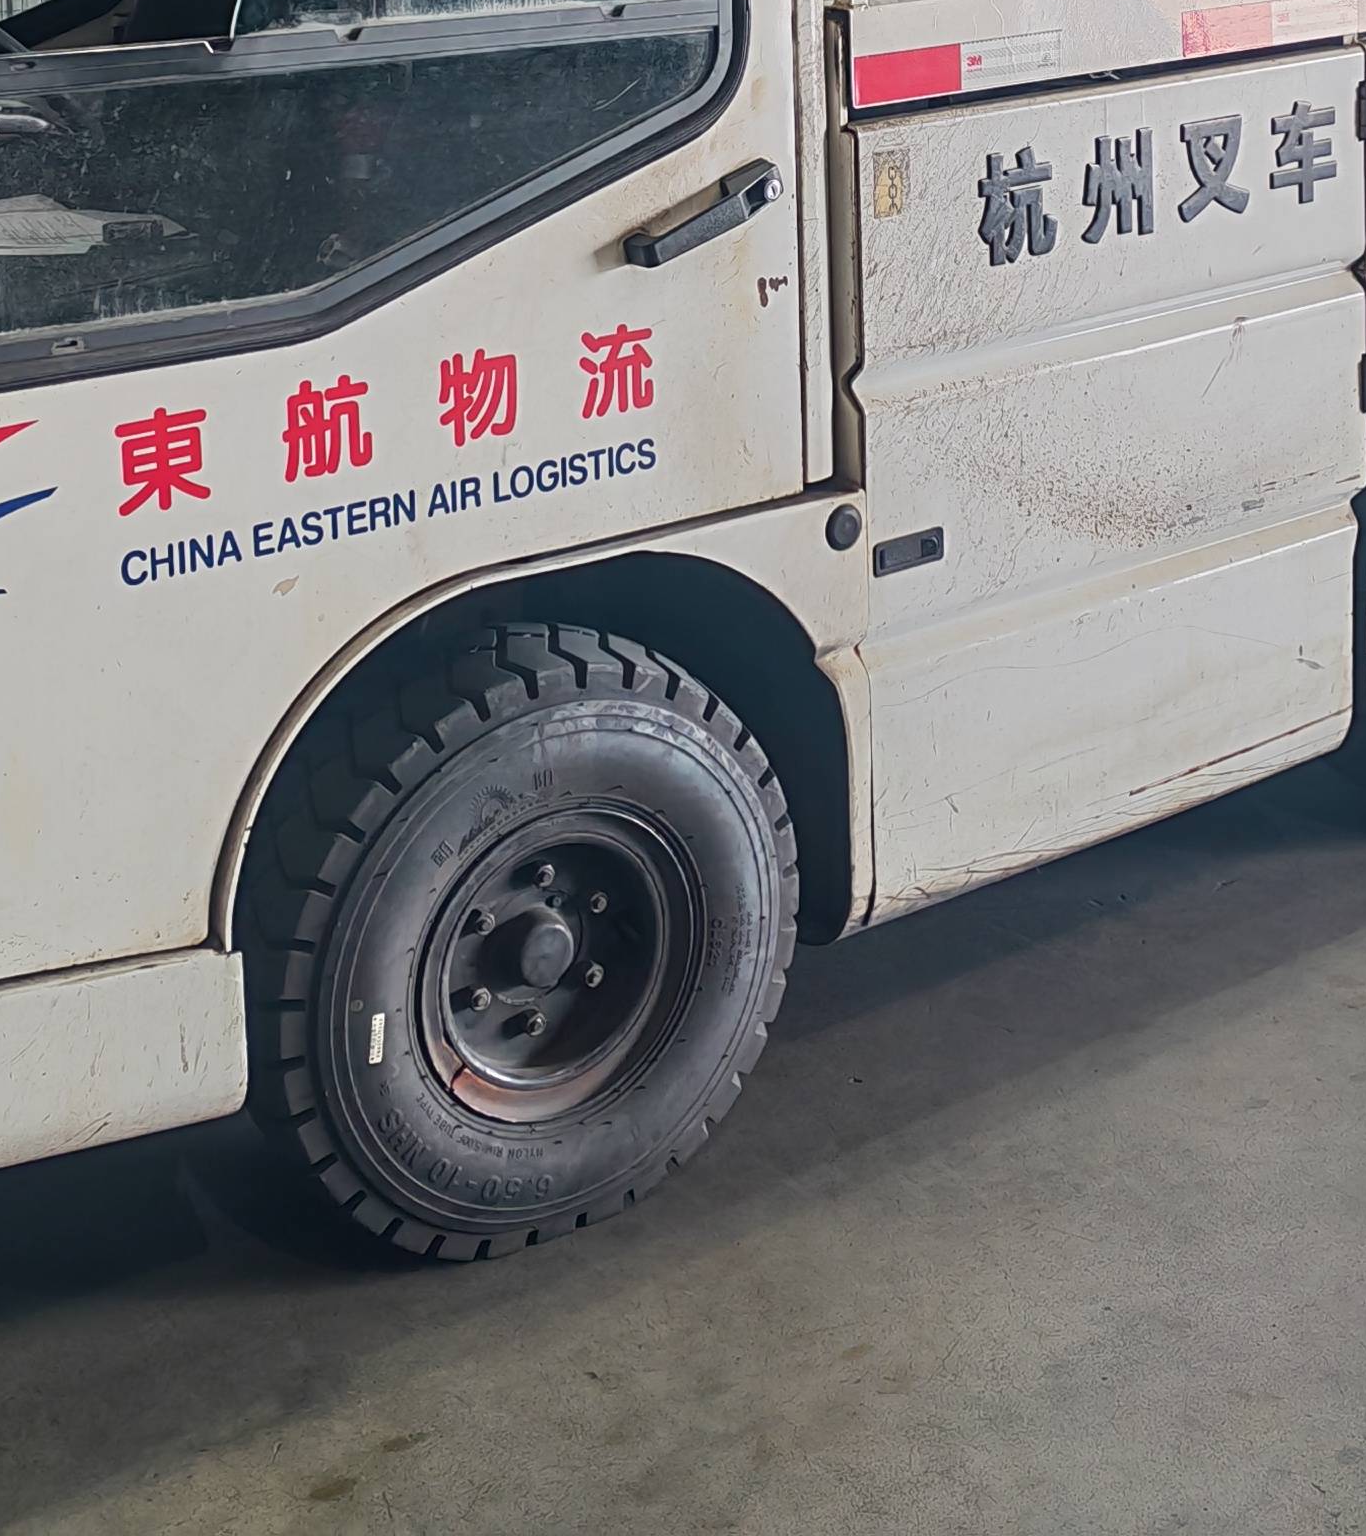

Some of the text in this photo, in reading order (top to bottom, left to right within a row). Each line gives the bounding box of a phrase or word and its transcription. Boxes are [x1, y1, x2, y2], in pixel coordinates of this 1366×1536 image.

[966, 55, 983, 67] 3M
[978, 100, 1337, 266] 杭州叉车
[115, 324, 654, 516] 東航物流
[121, 438, 656, 585] CHINA EASTERN AIR LOGISTICS
